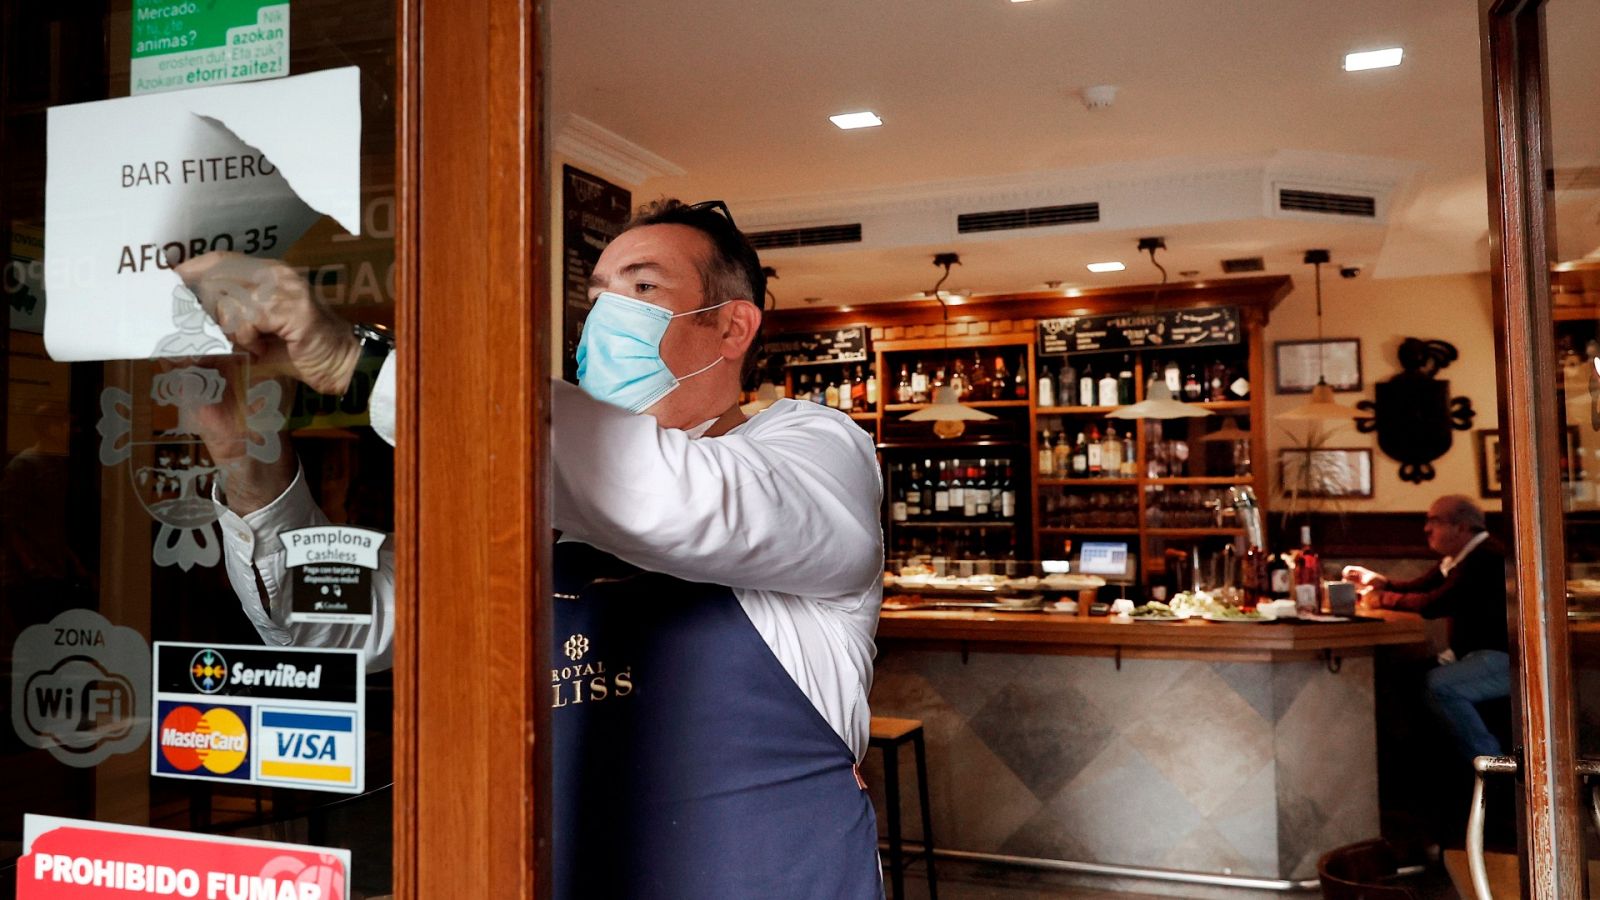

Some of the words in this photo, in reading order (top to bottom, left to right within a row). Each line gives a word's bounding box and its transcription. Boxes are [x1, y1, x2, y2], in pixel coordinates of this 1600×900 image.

[136, 30, 198, 53] animas?
[232, 26, 284, 45] azokan
[158, 54, 204, 71] erosten
[232, 47, 250, 61] Eta
[253, 42, 284, 59] zuk?
[136, 74, 183, 91] Azokara
[186, 66, 228, 83] etorri
[231, 56, 283, 79] zaitez!
[121, 160, 171, 188] BAR
[182, 153, 276, 184] FITERO
[117, 233, 234, 274] AFORO
[243, 225, 279, 255] 35
[291, 529, 372, 548] Pamplona
[306, 549, 358, 563] Cashless
[54, 628, 105, 647] ZONA
[230, 661, 322, 689] ServiRed
[551, 661, 606, 682] ROYAL
[551, 671, 633, 708] LISS
[160, 727, 247, 753] MasterCard
[276, 732, 337, 761] VISA
[34, 852, 200, 898] PROHIBIDO
[206, 871, 322, 900] FUMAR
